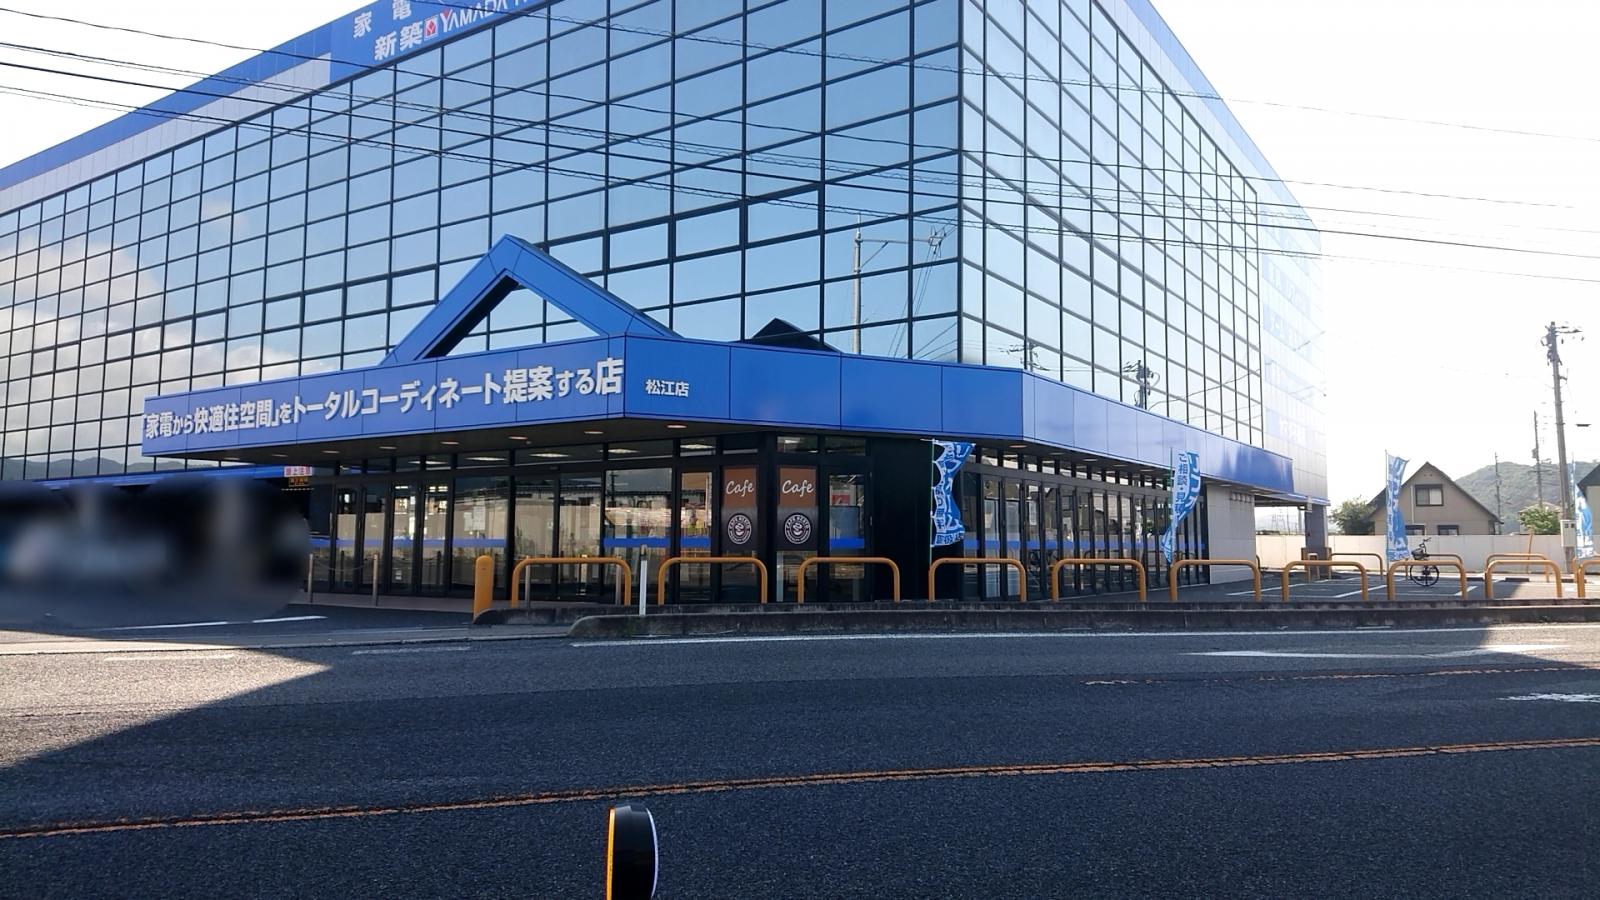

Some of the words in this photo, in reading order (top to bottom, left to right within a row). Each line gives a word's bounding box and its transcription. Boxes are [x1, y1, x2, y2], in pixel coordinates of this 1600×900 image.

[374, 21, 424, 60] 新築
[645, 379, 690, 398] 松江店
[725, 479, 755, 498] Cafe
[782, 479, 815, 498] Cafe
